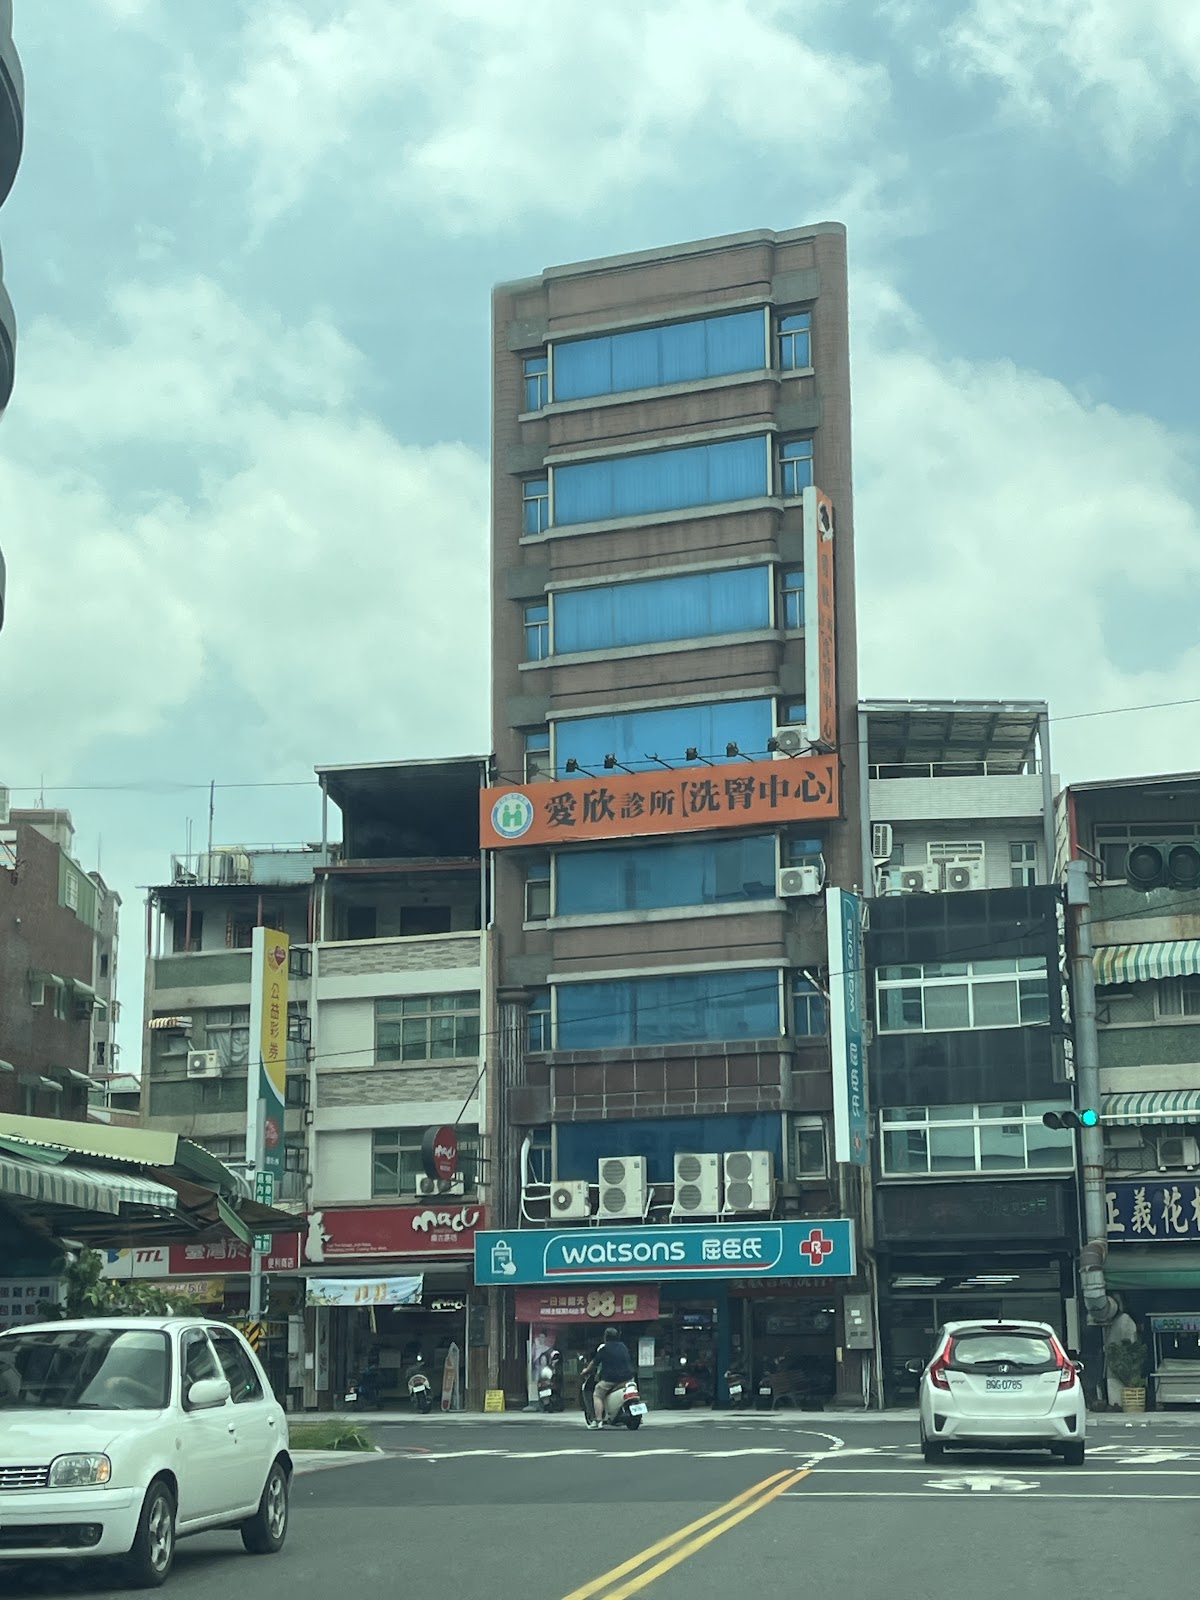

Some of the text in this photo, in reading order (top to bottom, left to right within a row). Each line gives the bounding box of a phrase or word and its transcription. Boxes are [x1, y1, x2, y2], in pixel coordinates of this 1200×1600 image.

[846, 918, 855, 1013] watsons
[269, 982, 280, 1059] 公益彩券
[136, 1250, 164, 1263] TTL
[184, 1236, 252, 1260] 臺灣菸
[561, 1237, 762, 1264] watsons 屈臣氏
[267, 1257, 295, 1269] 便利商店
